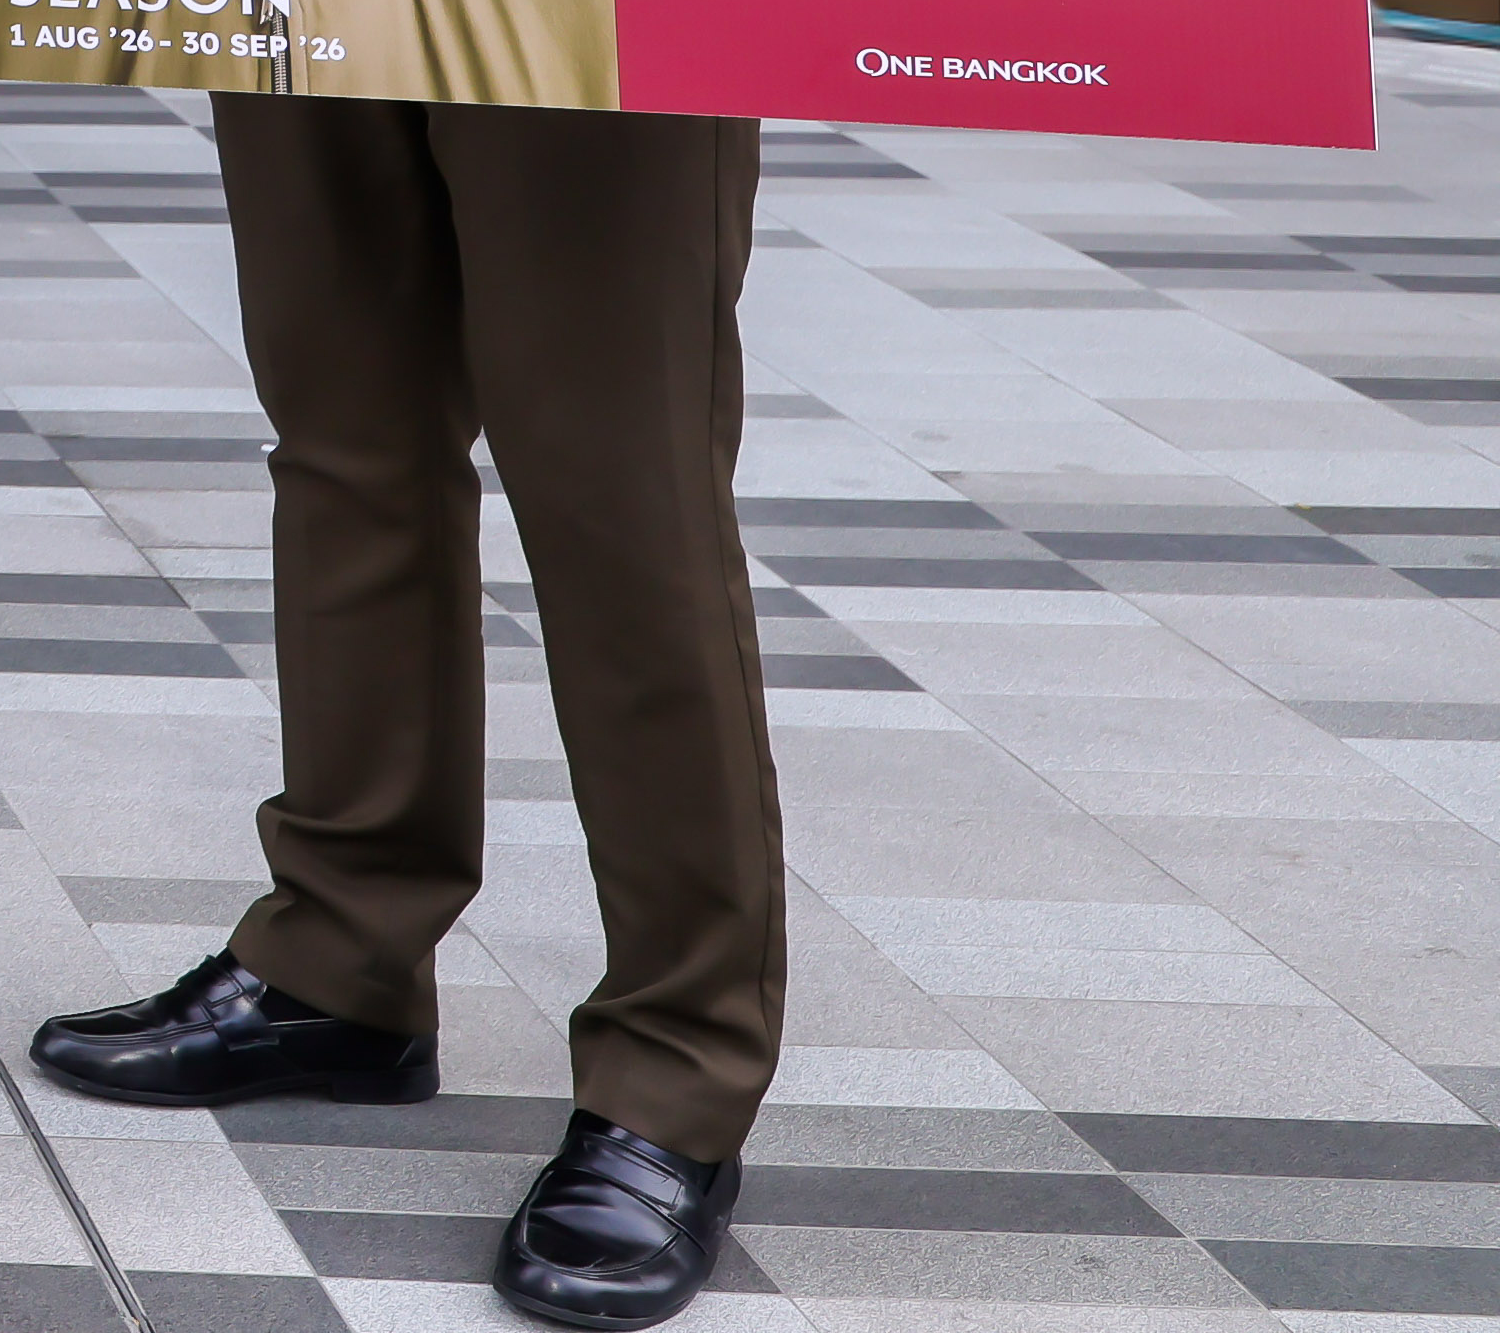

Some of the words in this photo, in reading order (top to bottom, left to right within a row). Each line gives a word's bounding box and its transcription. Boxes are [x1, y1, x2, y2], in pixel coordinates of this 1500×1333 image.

[9, 23, 26, 47] 1
[34, 25, 100, 50] AUG
[182, 31, 221, 56] 30
[229, 34, 288, 58] SEP
[943, 57, 1110, 86] BANGKOK
